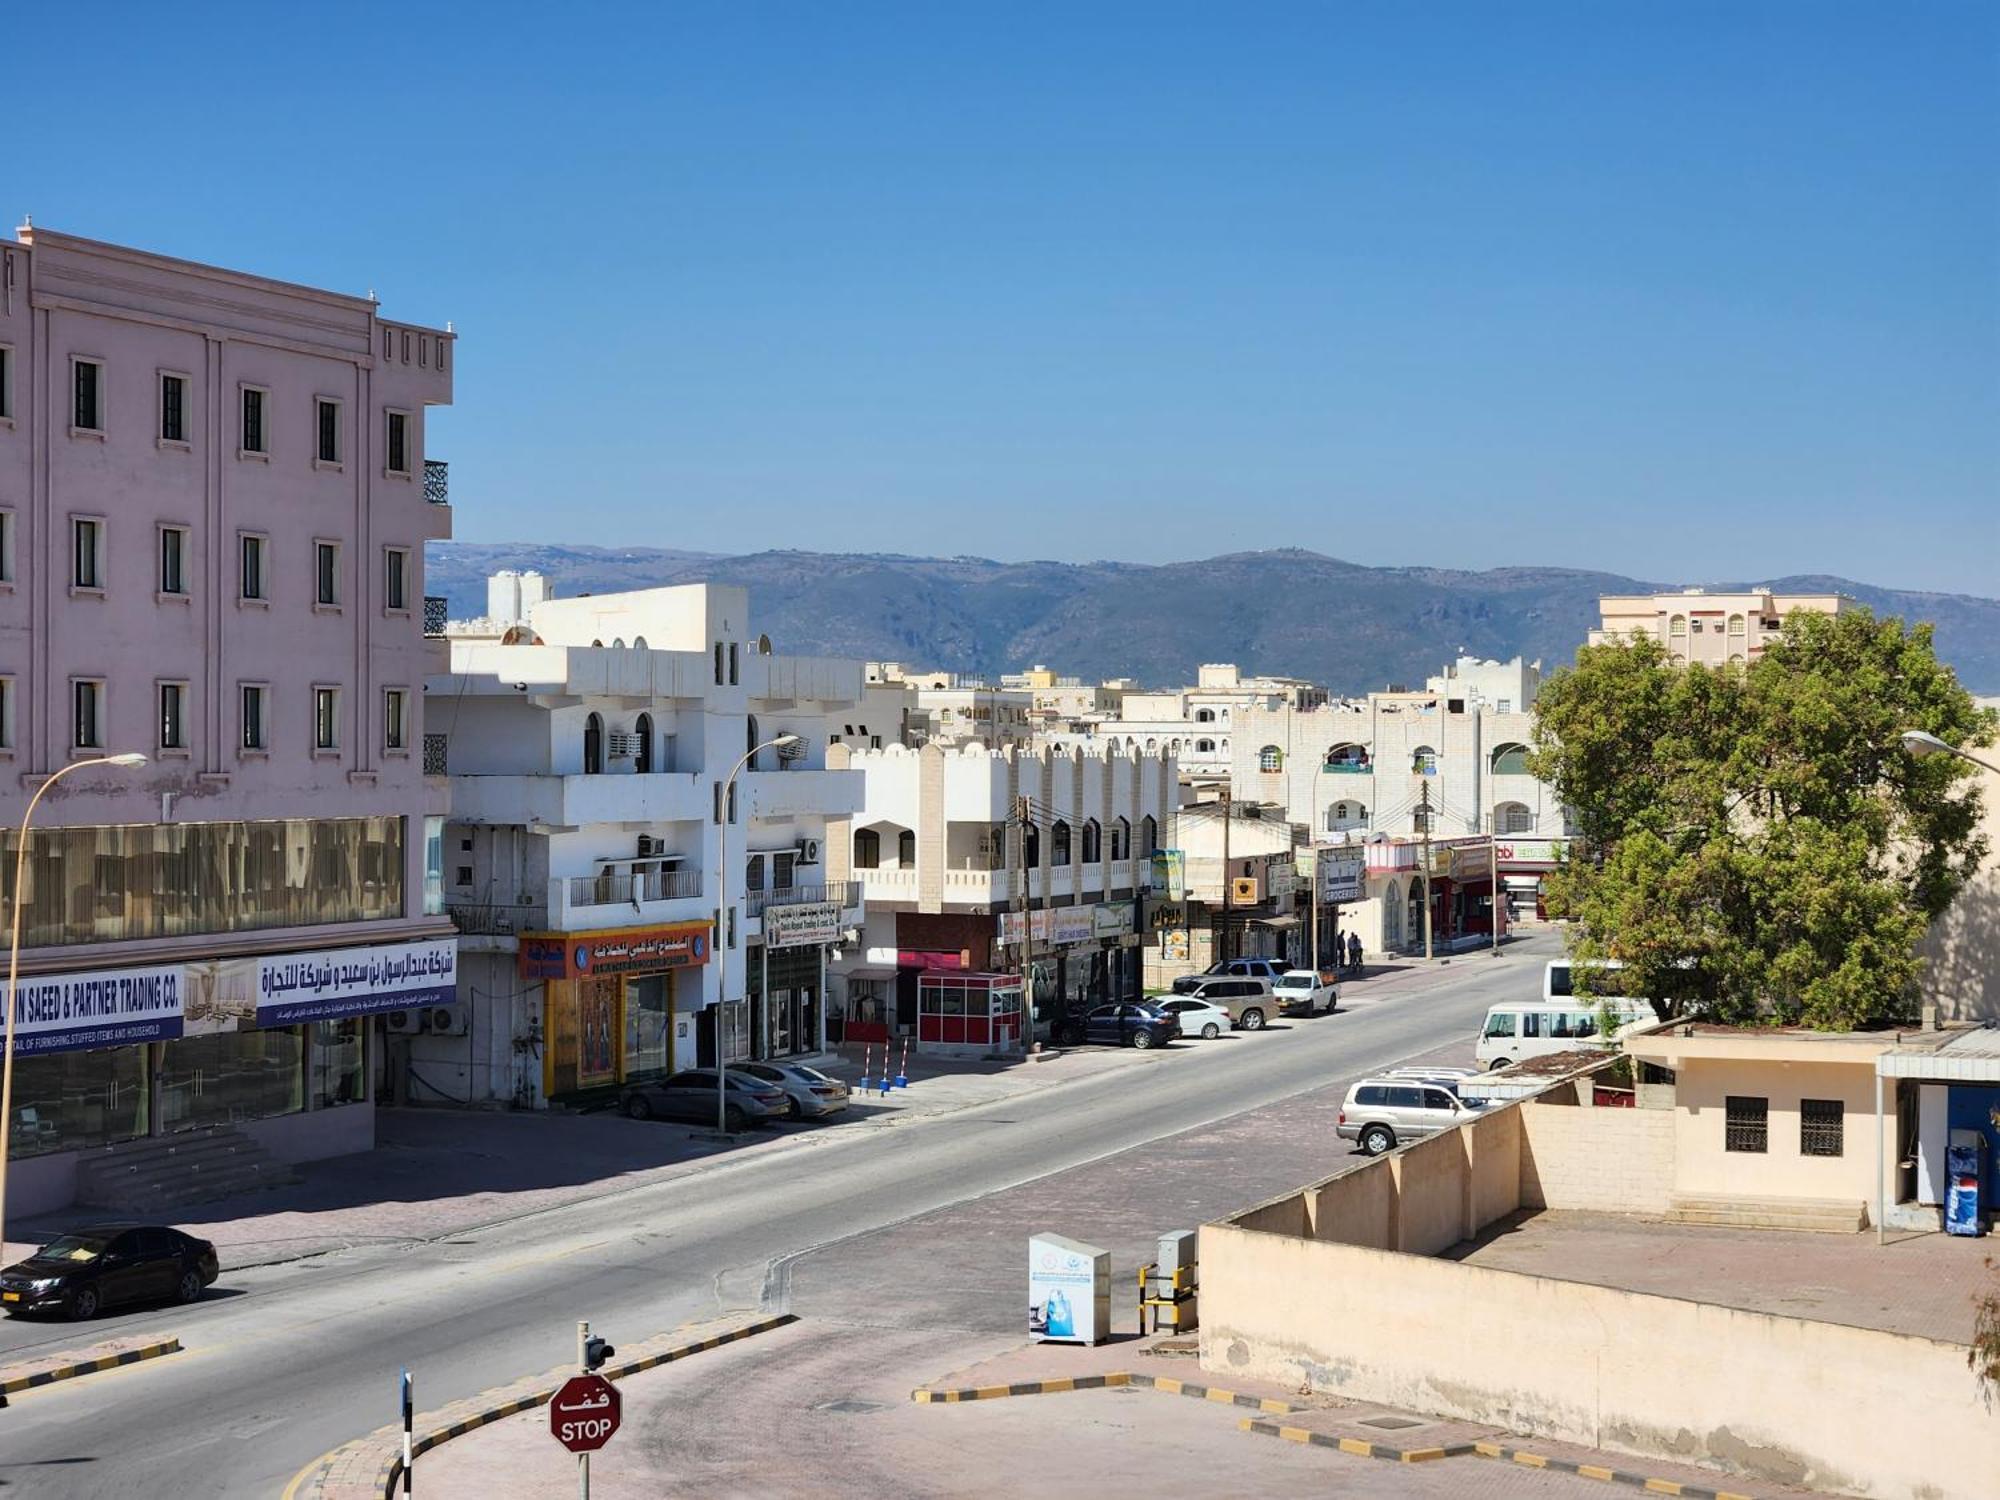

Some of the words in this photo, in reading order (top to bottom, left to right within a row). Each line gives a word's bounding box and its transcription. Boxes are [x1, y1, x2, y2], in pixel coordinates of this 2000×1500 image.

[428, 945, 453, 980] شركة
[262, 964, 299, 998] للتجارة
[341, 963, 369, 990] سعيد
[8, 986, 26, 1025] IN
[28, 985, 61, 1024] SAEED
[63, 983, 71, 1019] &
[73, 980, 117, 1018] PARTNER
[119, 975, 161, 1014] TRADING
[163, 973, 179, 1009] CO.
[26, 1038, 35, 1050] OF
[127, 1023, 160, 1038] HOUSEHOLD
[559, 1387, 610, 1412] قف
[561, 1418, 612, 1442] STOP
